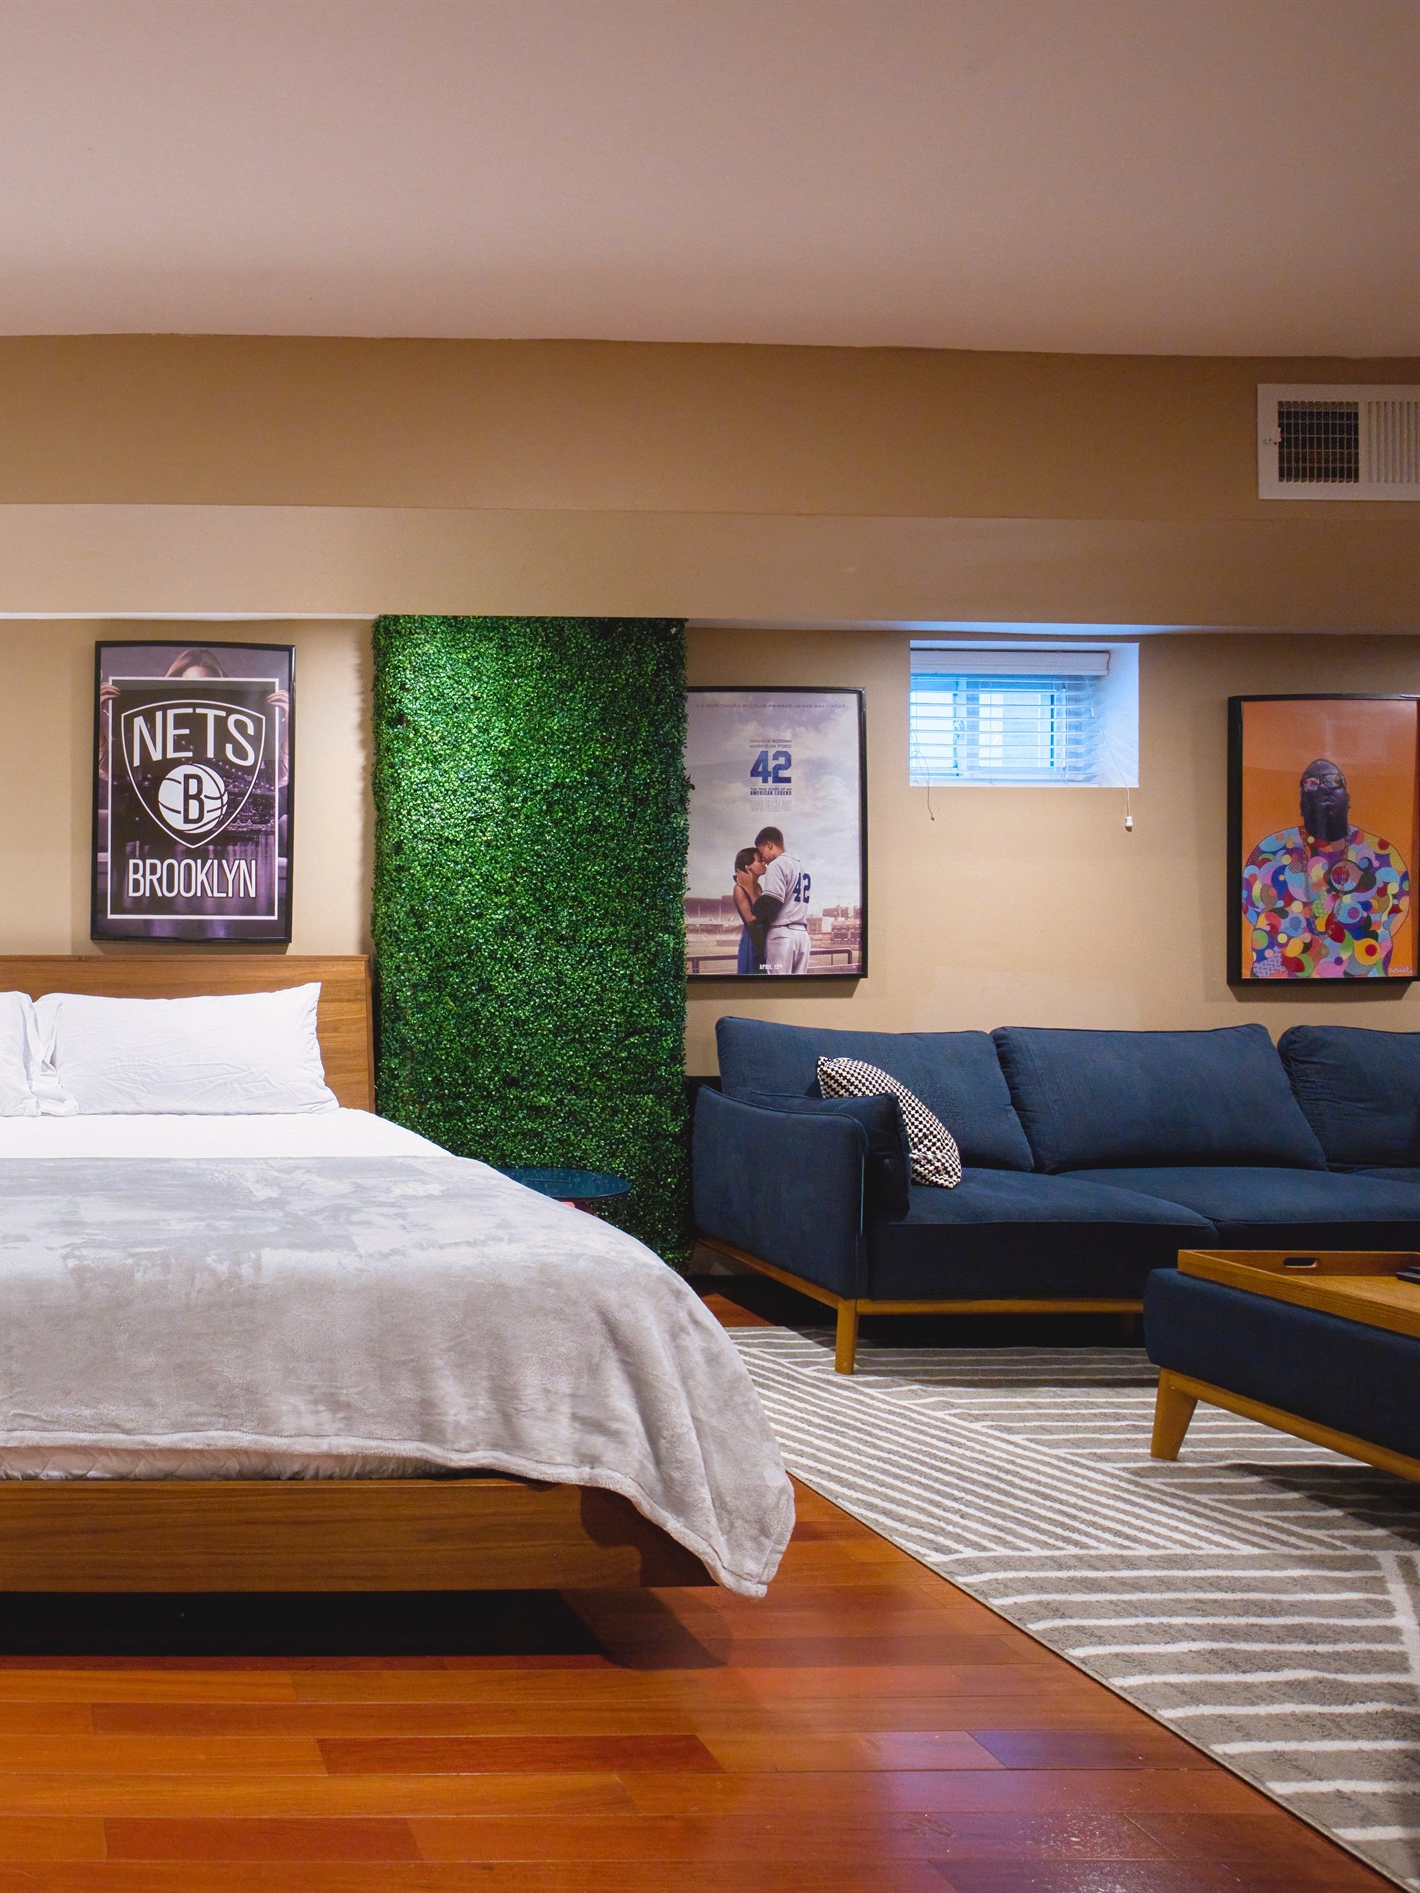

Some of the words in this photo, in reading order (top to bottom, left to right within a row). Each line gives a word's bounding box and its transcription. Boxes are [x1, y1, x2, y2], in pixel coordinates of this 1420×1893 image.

[133, 707, 255, 767] NETS
[750, 750, 792, 784] 42
[183, 773, 205, 825] B
[128, 858, 256, 898] BROOKLYN
[792, 872, 811, 904] 42
